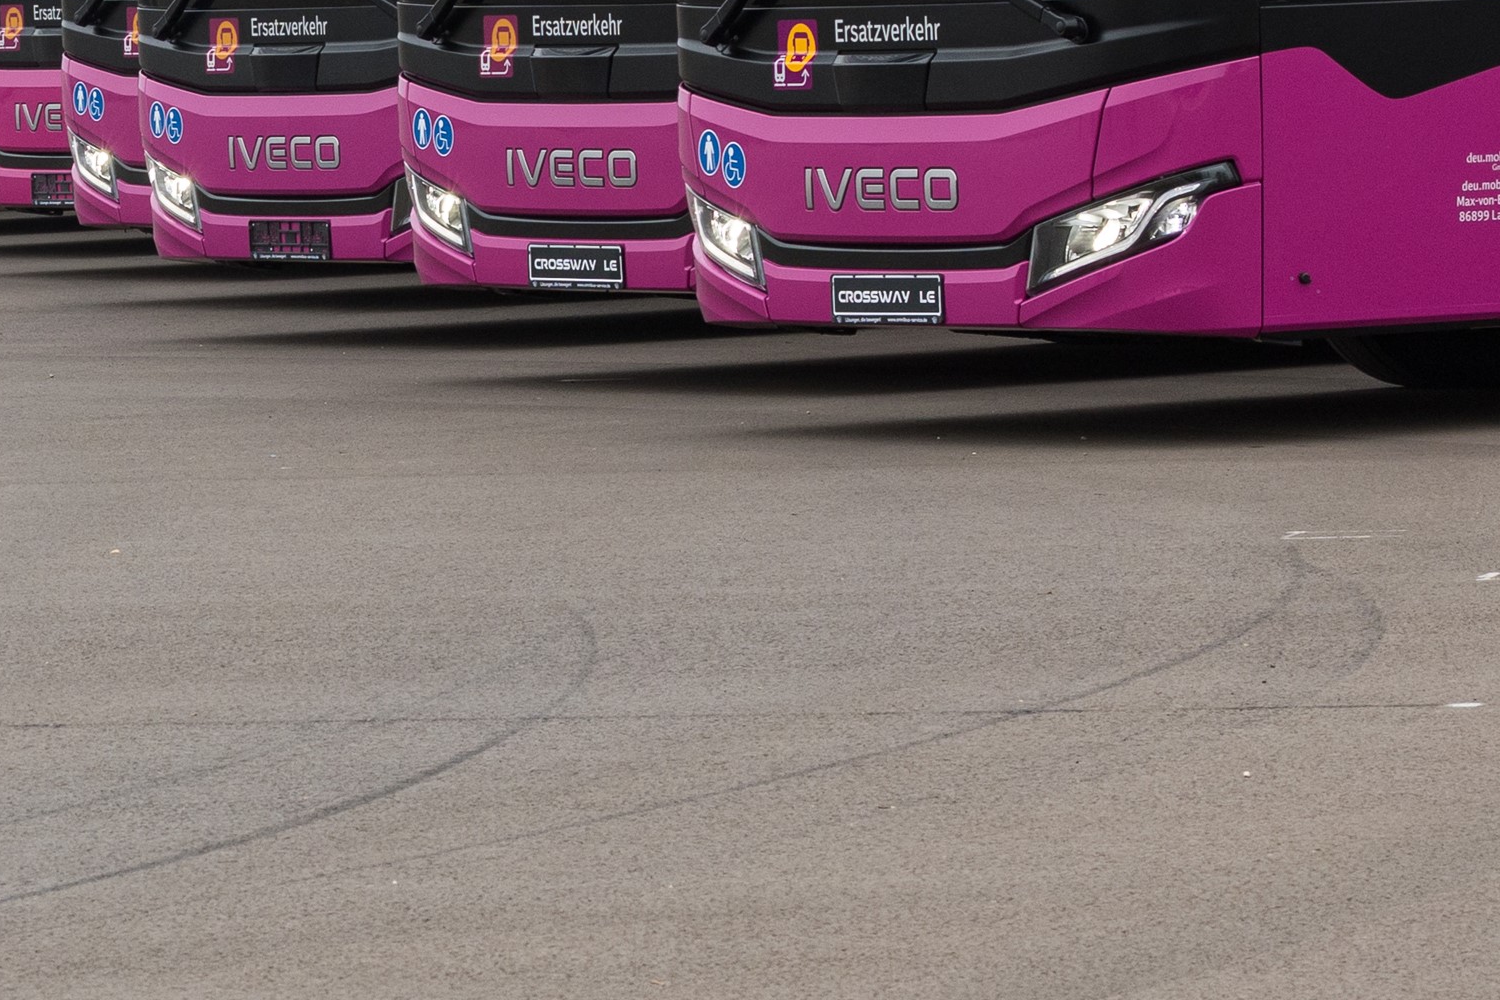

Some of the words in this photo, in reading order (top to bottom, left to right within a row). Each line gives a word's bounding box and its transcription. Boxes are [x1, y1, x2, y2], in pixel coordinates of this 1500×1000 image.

[33, 4, 62, 20] Ersatz
[250, 15, 328, 37] Ersatzverkehr
[532, 13, 622, 37] Ersatzverkehr
[834, 16, 941, 43] Ersatzverkehr
[228, 135, 341, 171] IVECO
[1466, 152, 1500, 163] deu.mo
[506, 148, 638, 188] IVECO
[804, 167, 959, 213] IVECO
[1459, 209, 1490, 222] 86899
[534, 258, 597, 271] CROSSWAY
[603, 260, 618, 271] LE
[838, 290, 911, 304] CROSSWAY
[919, 291, 936, 304] LE
